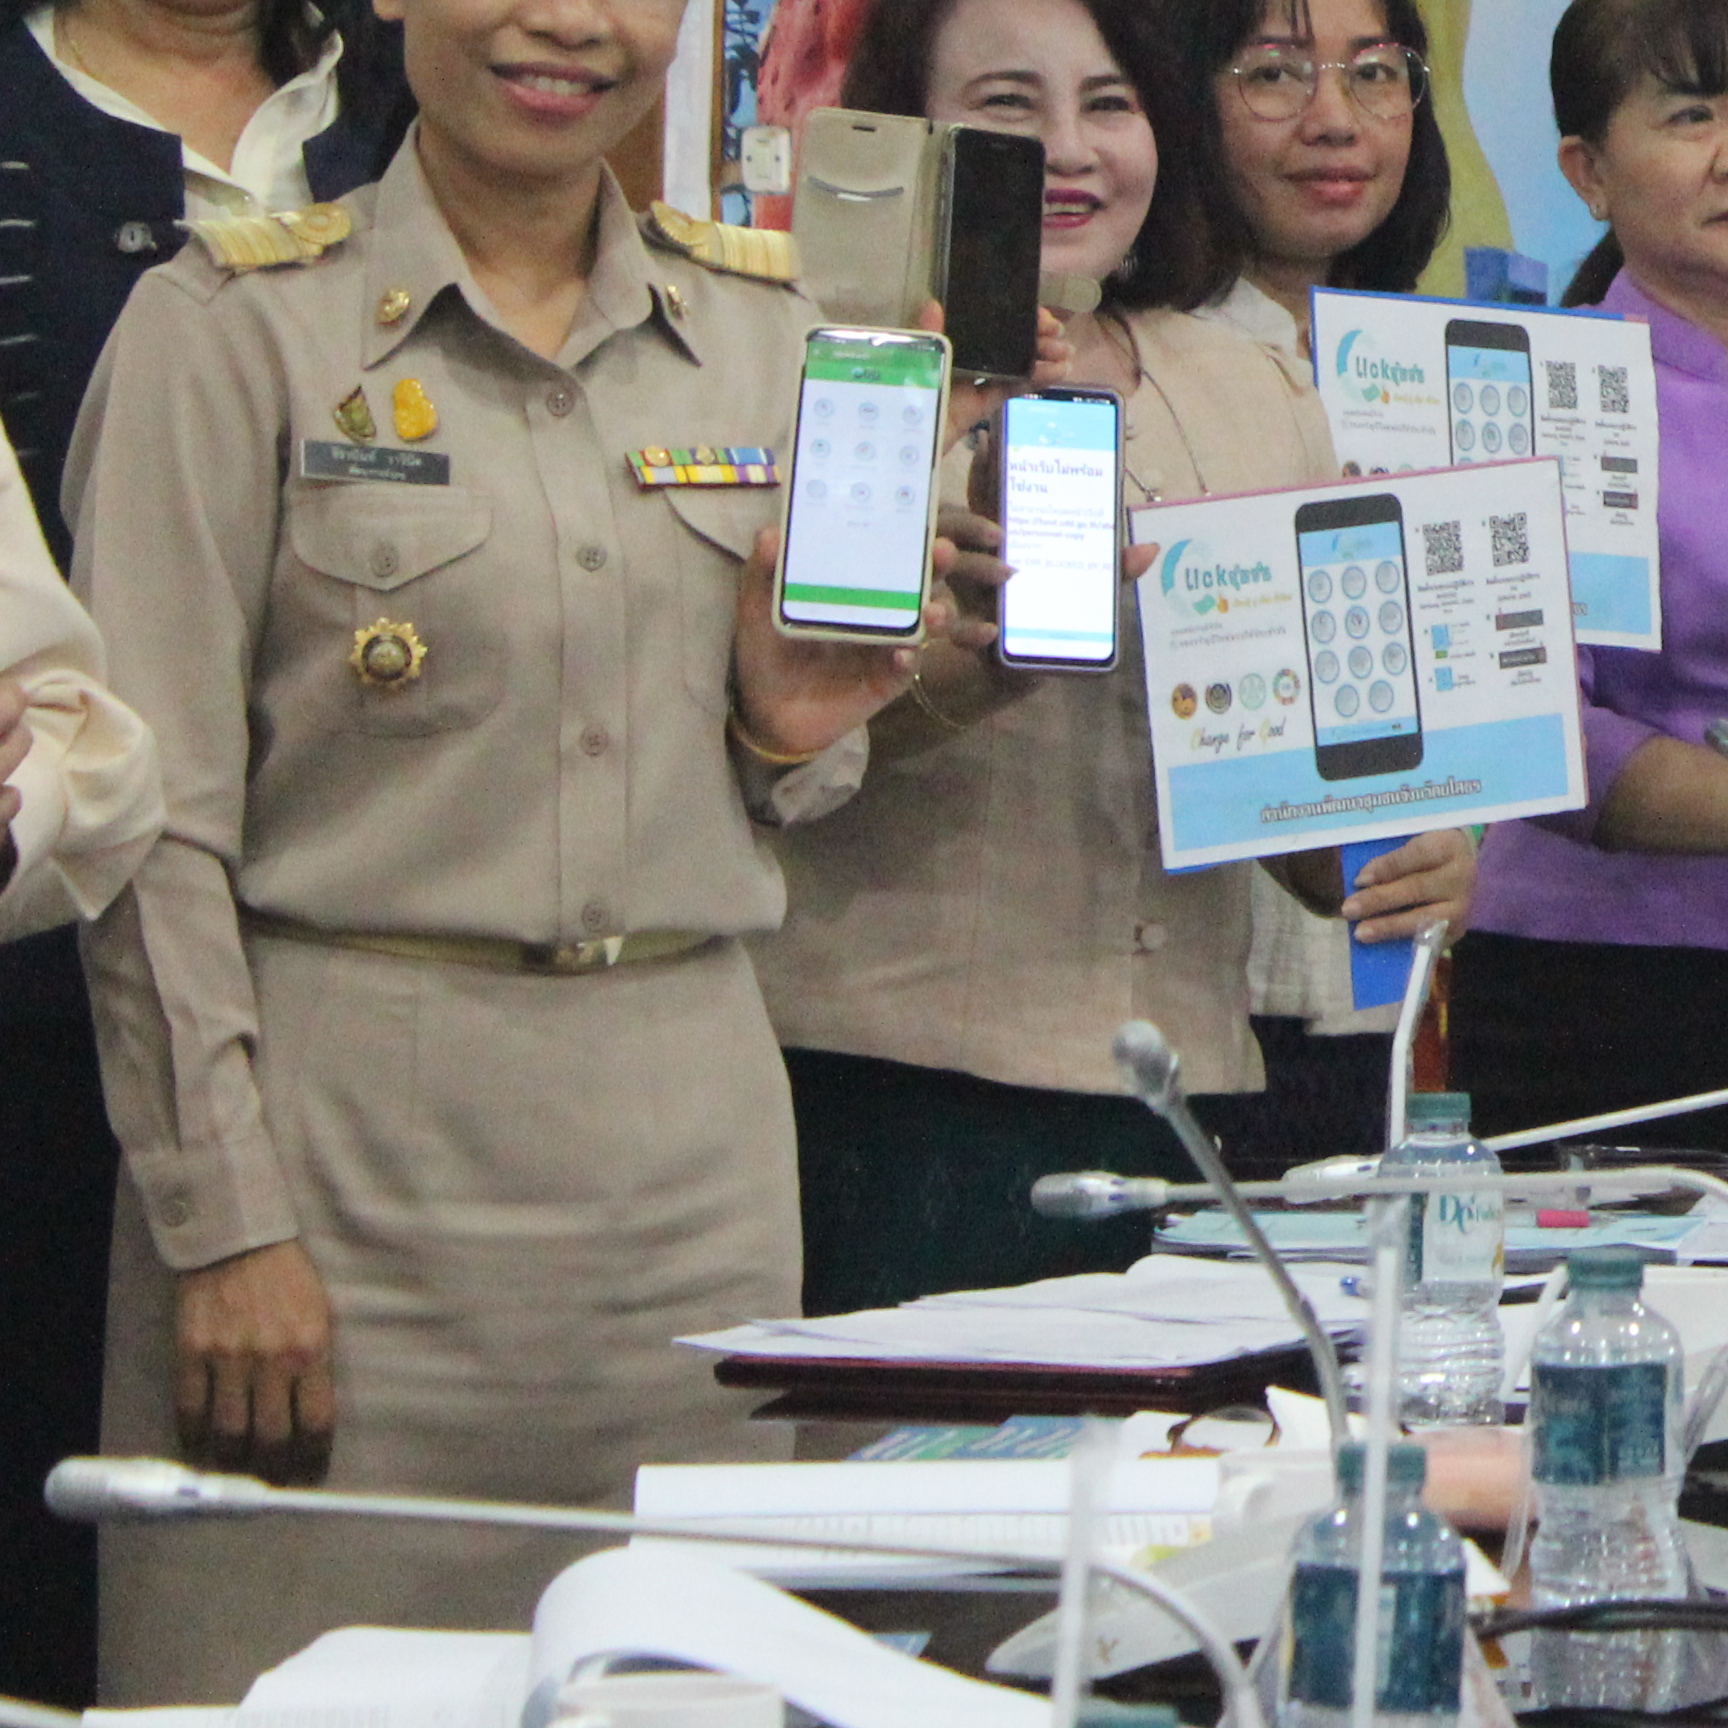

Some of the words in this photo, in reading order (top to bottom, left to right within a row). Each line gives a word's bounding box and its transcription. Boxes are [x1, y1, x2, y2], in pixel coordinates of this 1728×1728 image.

[1190, 727, 1230, 754] Change
[1236, 722, 1256, 750] for
[1258, 716, 1285, 745] Good
